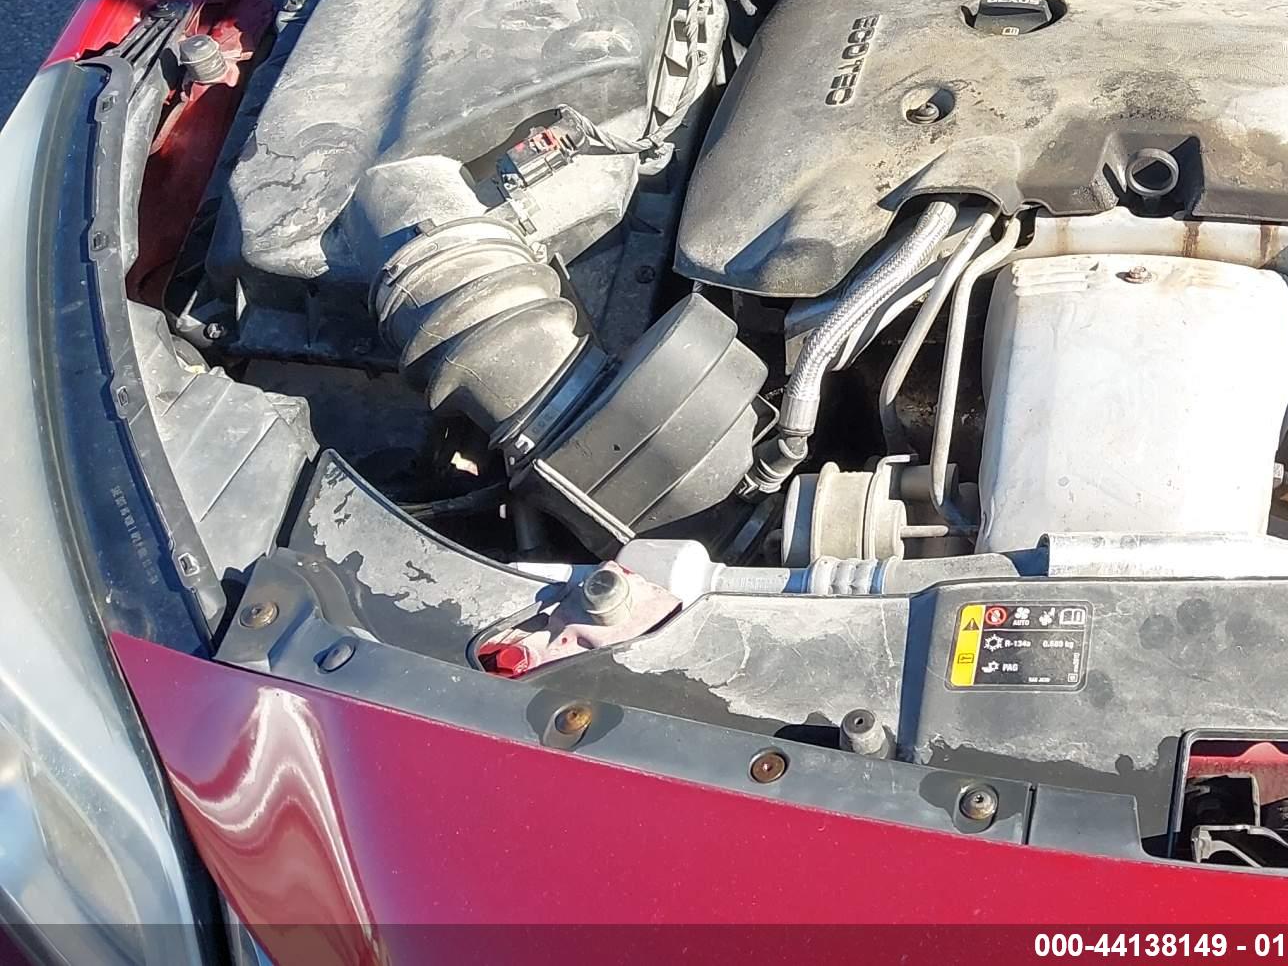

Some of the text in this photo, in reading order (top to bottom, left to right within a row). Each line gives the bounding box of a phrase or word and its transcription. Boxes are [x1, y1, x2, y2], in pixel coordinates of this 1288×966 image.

[825, 14, 881, 106] ECOTEC
[1004, 639, 1031, 647] R-134a
[1002, 663, 1019, 672] PAG
